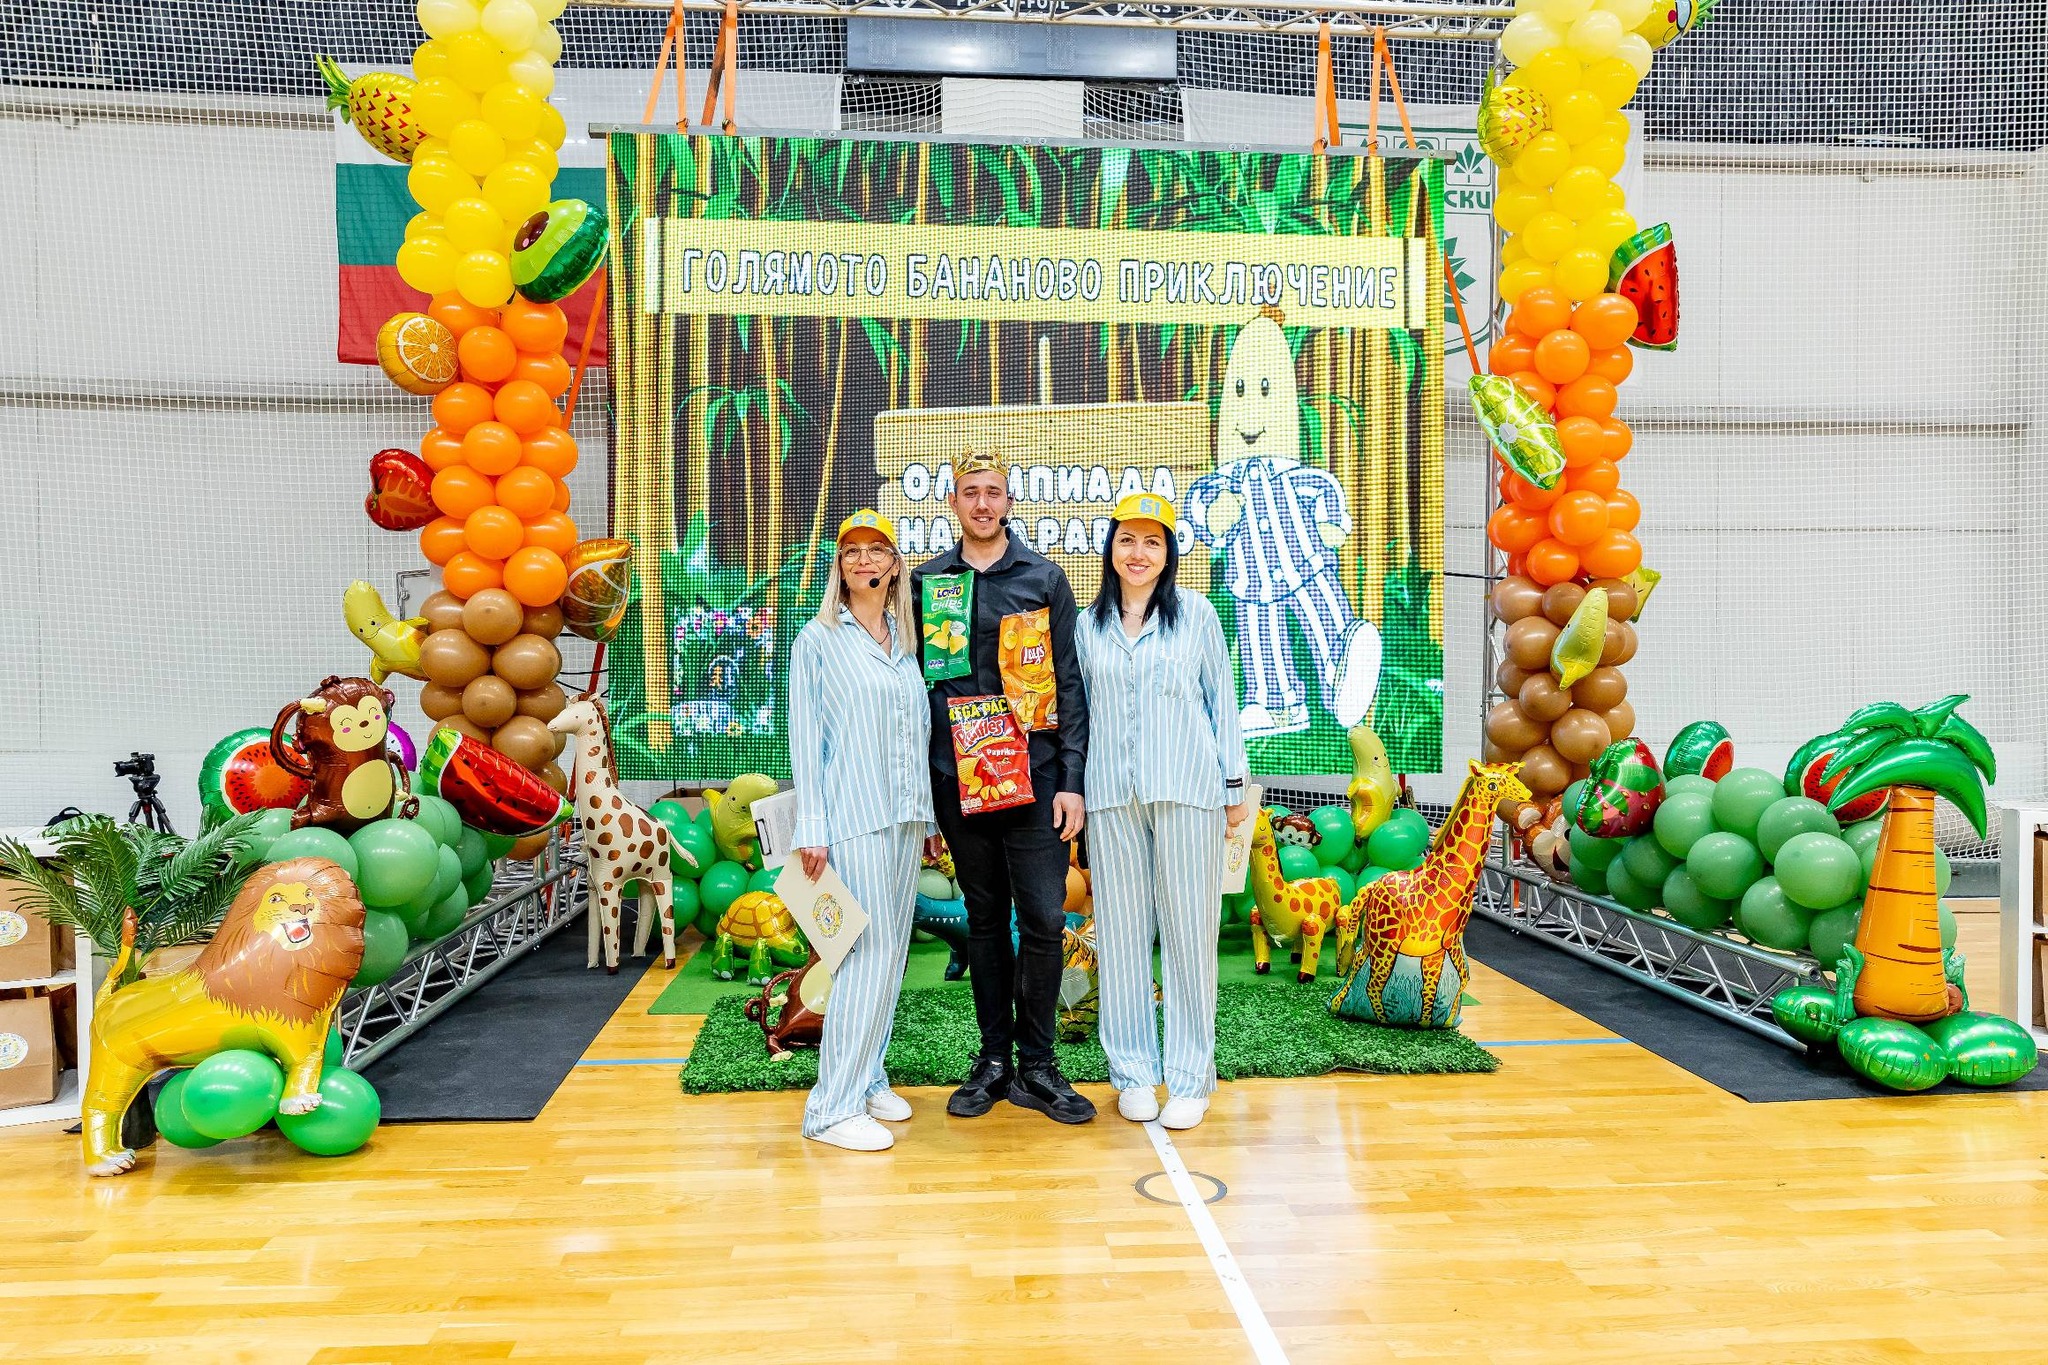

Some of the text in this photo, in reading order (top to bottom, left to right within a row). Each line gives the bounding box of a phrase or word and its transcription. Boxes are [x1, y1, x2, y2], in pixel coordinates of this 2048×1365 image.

[682, 248, 1399, 310] ГОЛЯМОТО БАНАНОВО ПРИКЛЮЧЕНИЕ
[901, 462, 1178, 506] ОЛМПИАДА
[852, 514, 878, 526] 62
[1140, 498, 1161, 517] 61
[898, 516, 955, 555] НА
[985, 698, 1009, 715] PAC
